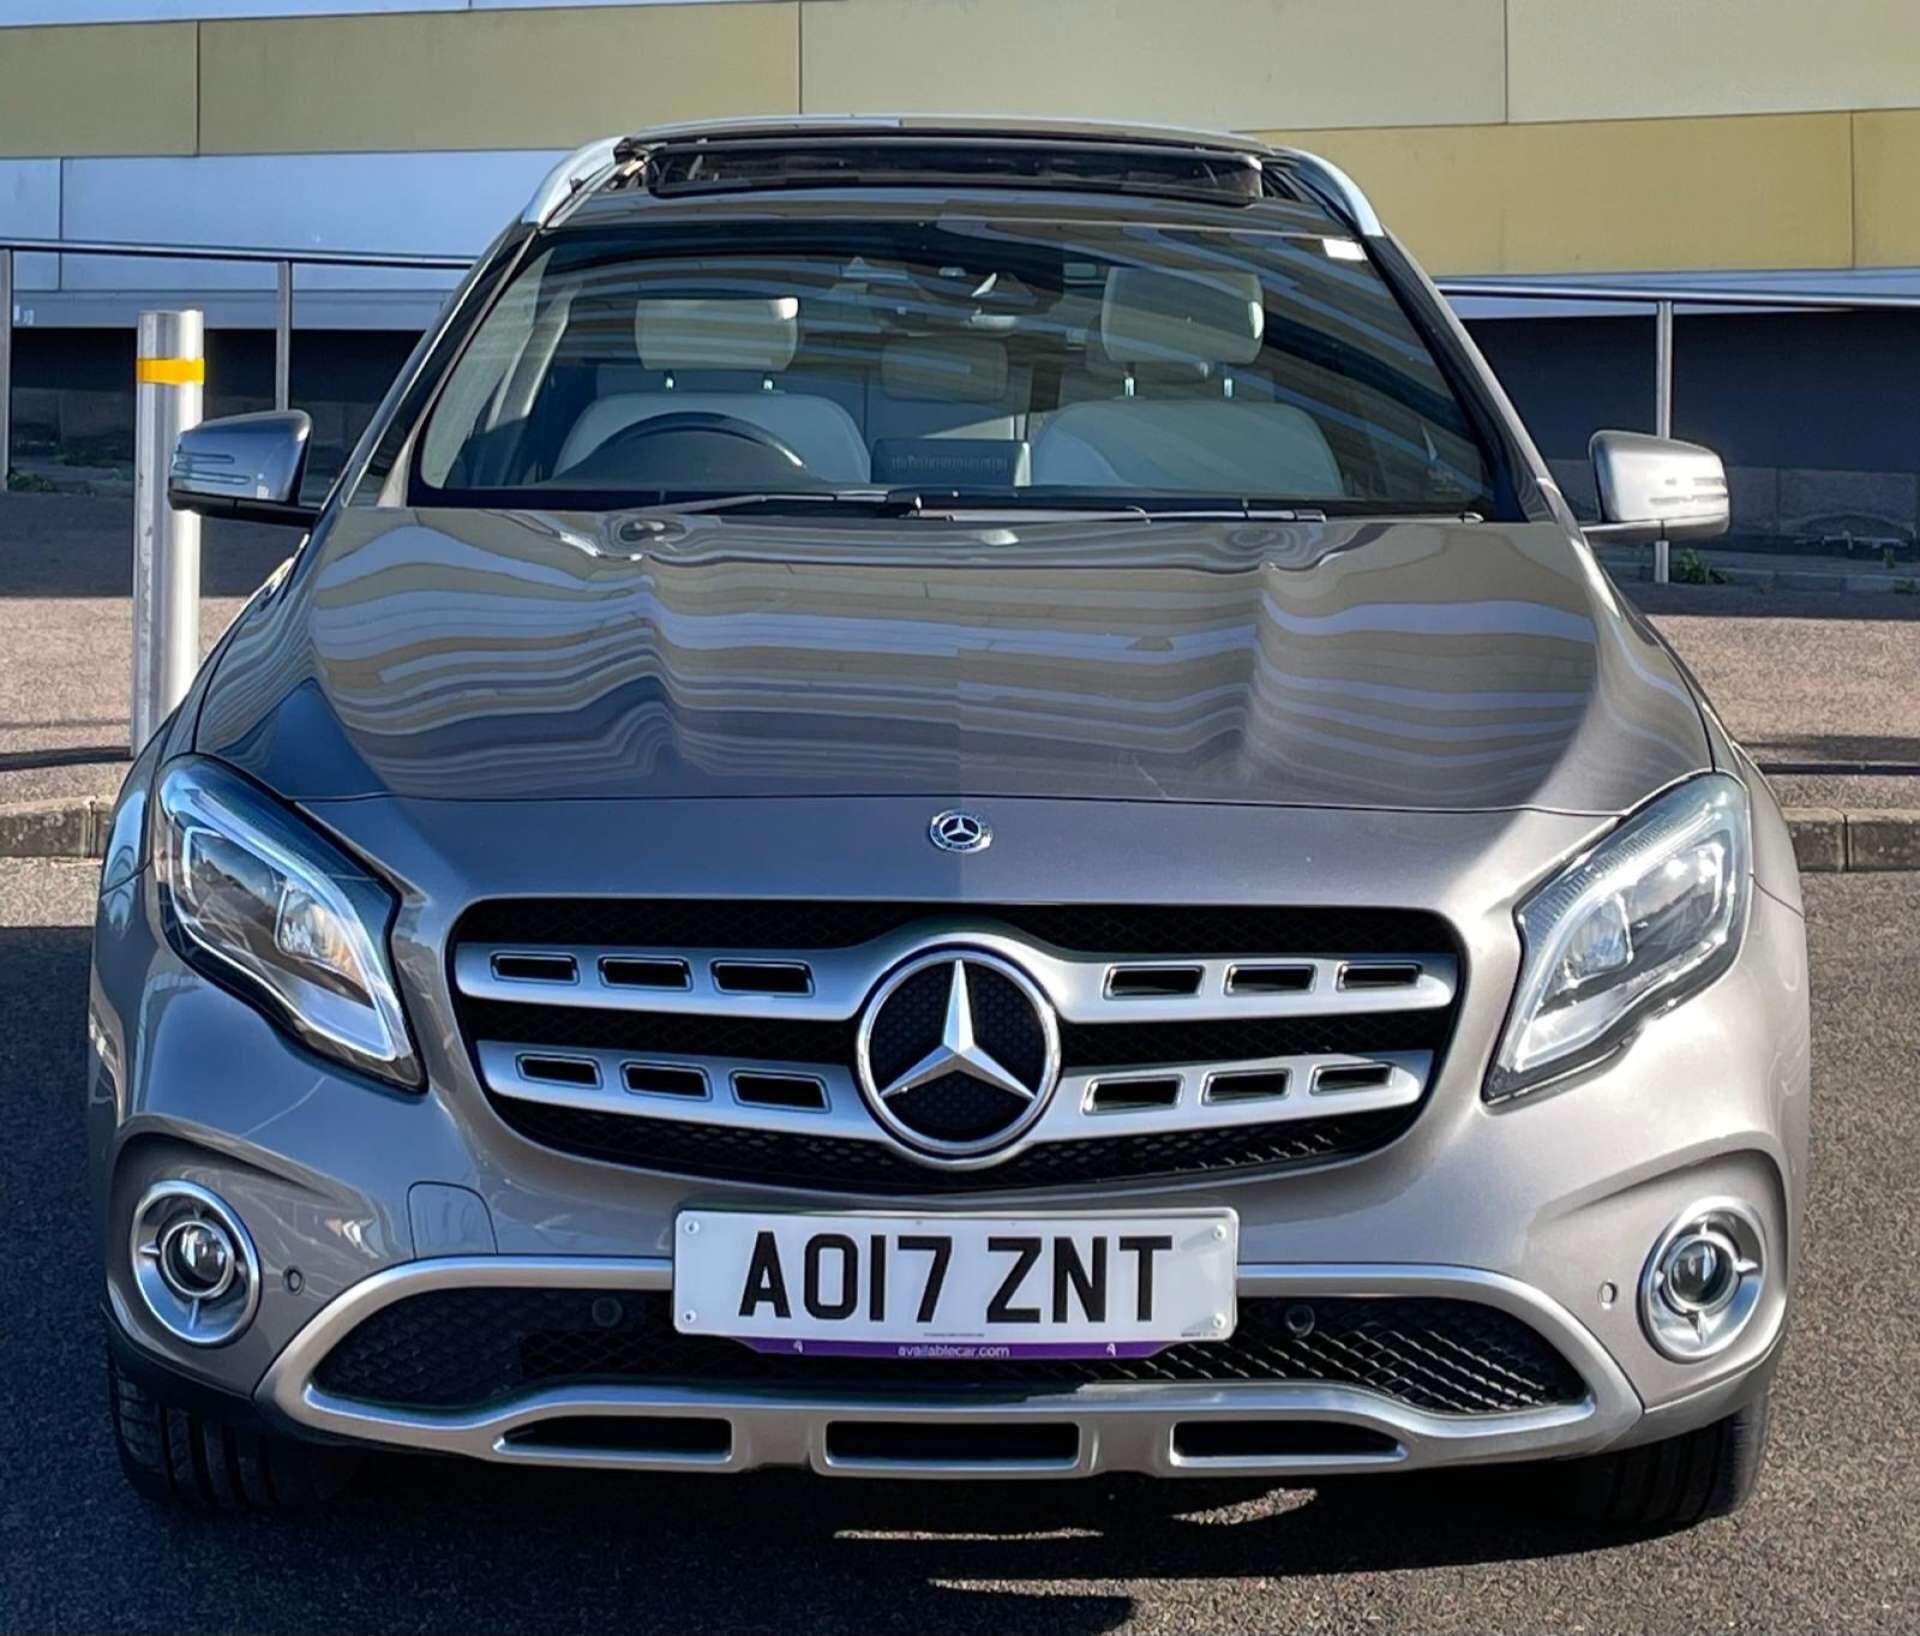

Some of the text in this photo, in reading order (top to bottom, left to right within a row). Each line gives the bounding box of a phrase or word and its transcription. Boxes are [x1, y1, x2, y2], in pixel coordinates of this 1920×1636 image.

[739, 1232, 1172, 1323] AO17 ZNT
[897, 1345, 1011, 1358] availablecar.com
